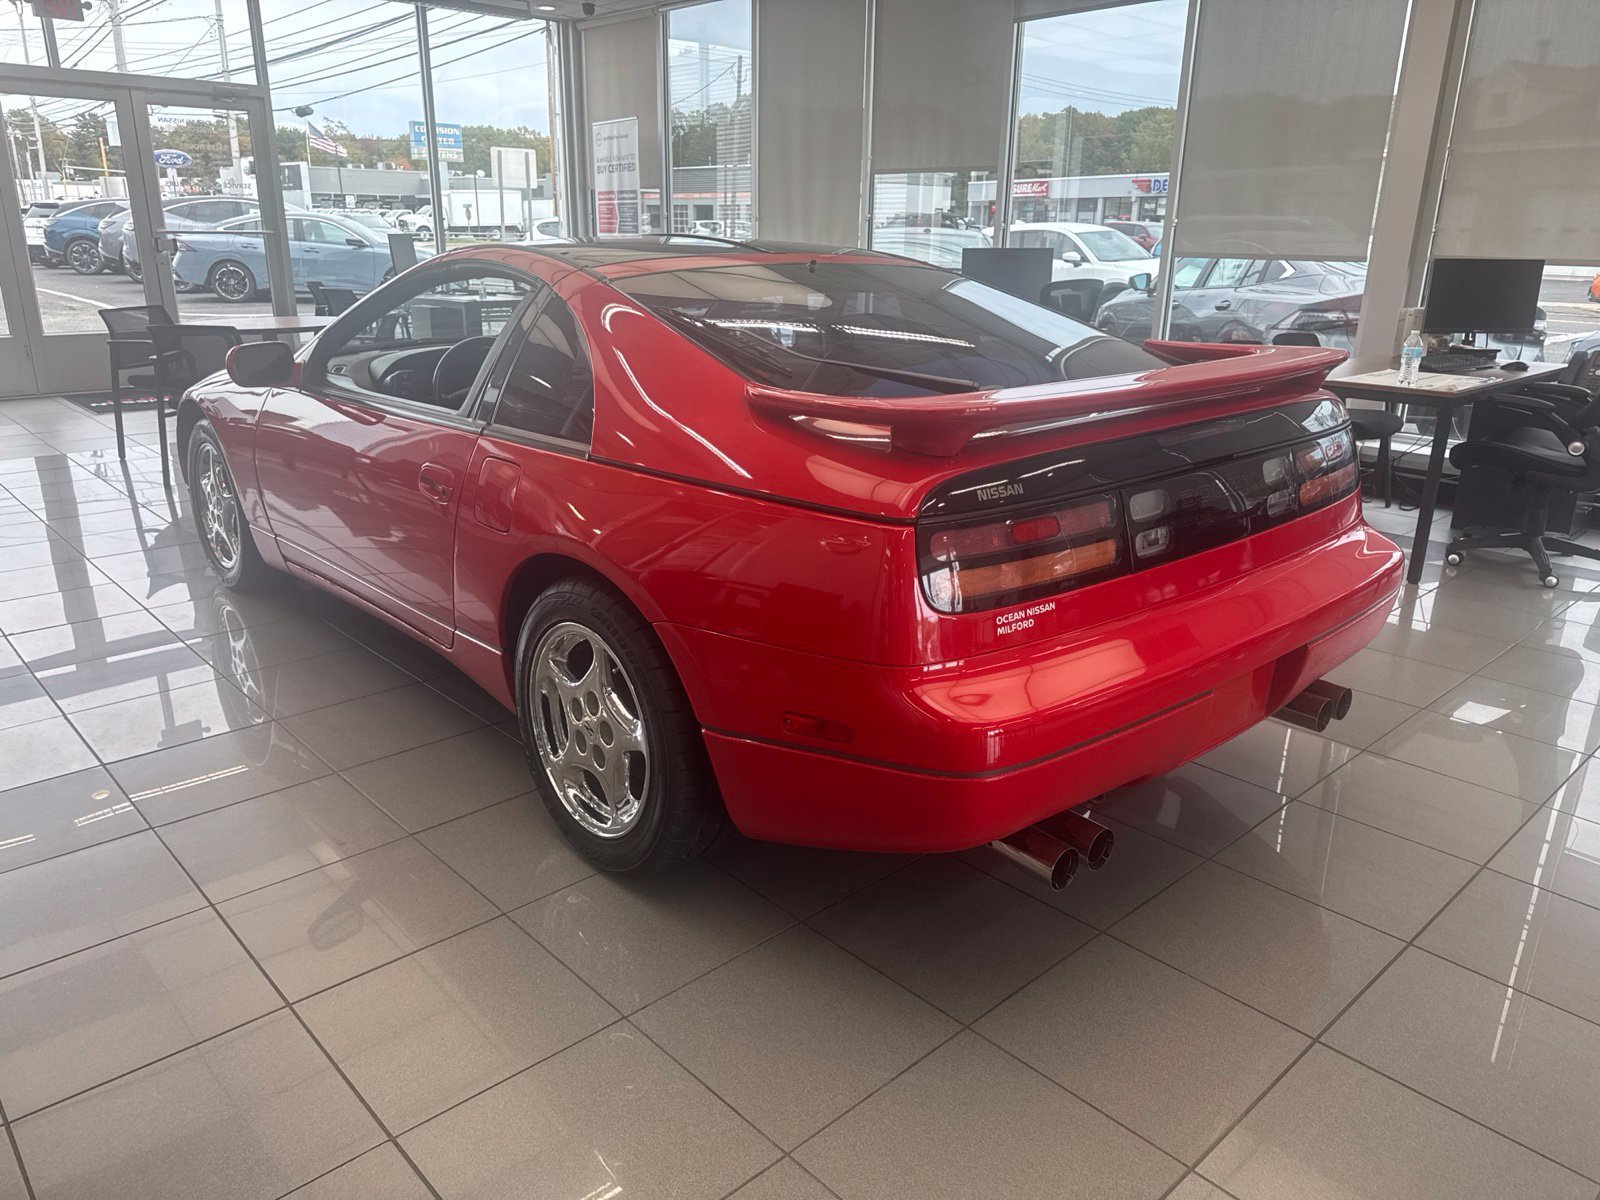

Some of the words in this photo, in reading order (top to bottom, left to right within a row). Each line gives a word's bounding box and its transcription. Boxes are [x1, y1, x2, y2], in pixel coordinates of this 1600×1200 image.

[414, 125, 460, 135] COISION
[421, 136, 455, 145] CTER
[158, 153, 184, 164] Ford
[608, 162, 636, 174] CERTIFIED
[976, 482, 1024, 502] NISSAN
[995, 609, 1026, 625] OCEAN
[1026, 601, 1056, 618] NISSAN
[996, 618, 1035, 636] MILFORD
